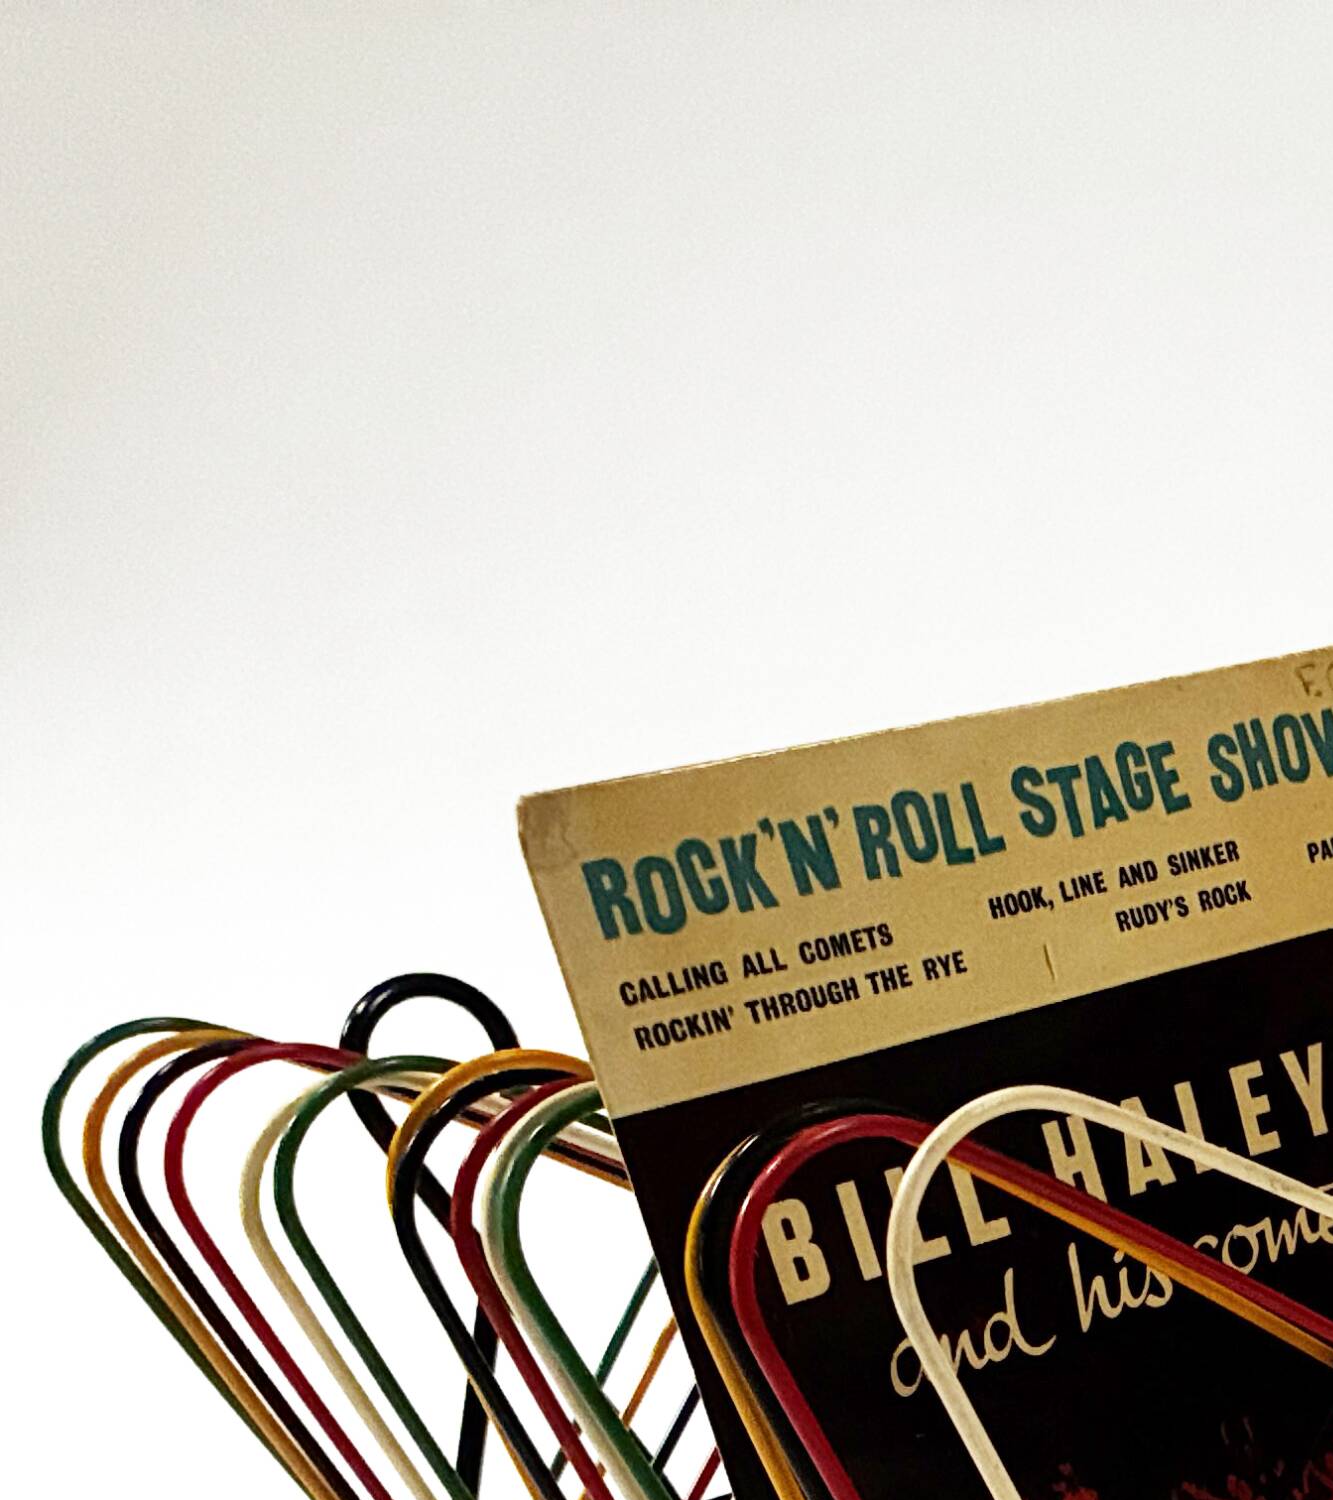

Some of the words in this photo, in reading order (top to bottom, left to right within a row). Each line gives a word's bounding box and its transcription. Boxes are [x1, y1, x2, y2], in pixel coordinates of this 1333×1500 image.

[1010, 740, 1192, 838] STAGE
[988, 884, 1055, 921] HOOK,
[1058, 870, 1108, 904] LINE
[1118, 858, 1159, 890] AND
[1169, 839, 1242, 877] SINKER
[1114, 896, 1190, 933] RUDY'S
[1200, 879, 1253, 912] ROCK
[618, 959, 729, 1007] CALLING
[741, 947, 788, 978] ALL
[798, 922, 894, 965] COMETS
[633, 1005, 735, 1052] ROCKIN'
[743, 975, 861, 1026] THROUGH
[864, 963, 914, 994] THE
[921, 950, 968, 981] RYE
[760, 1157, 1012, 1306] BILL
[1040, 1041, 1329, 1204] HALEY
[890, 1266, 1057, 1398] and
[1067, 1242, 1174, 1333] his
